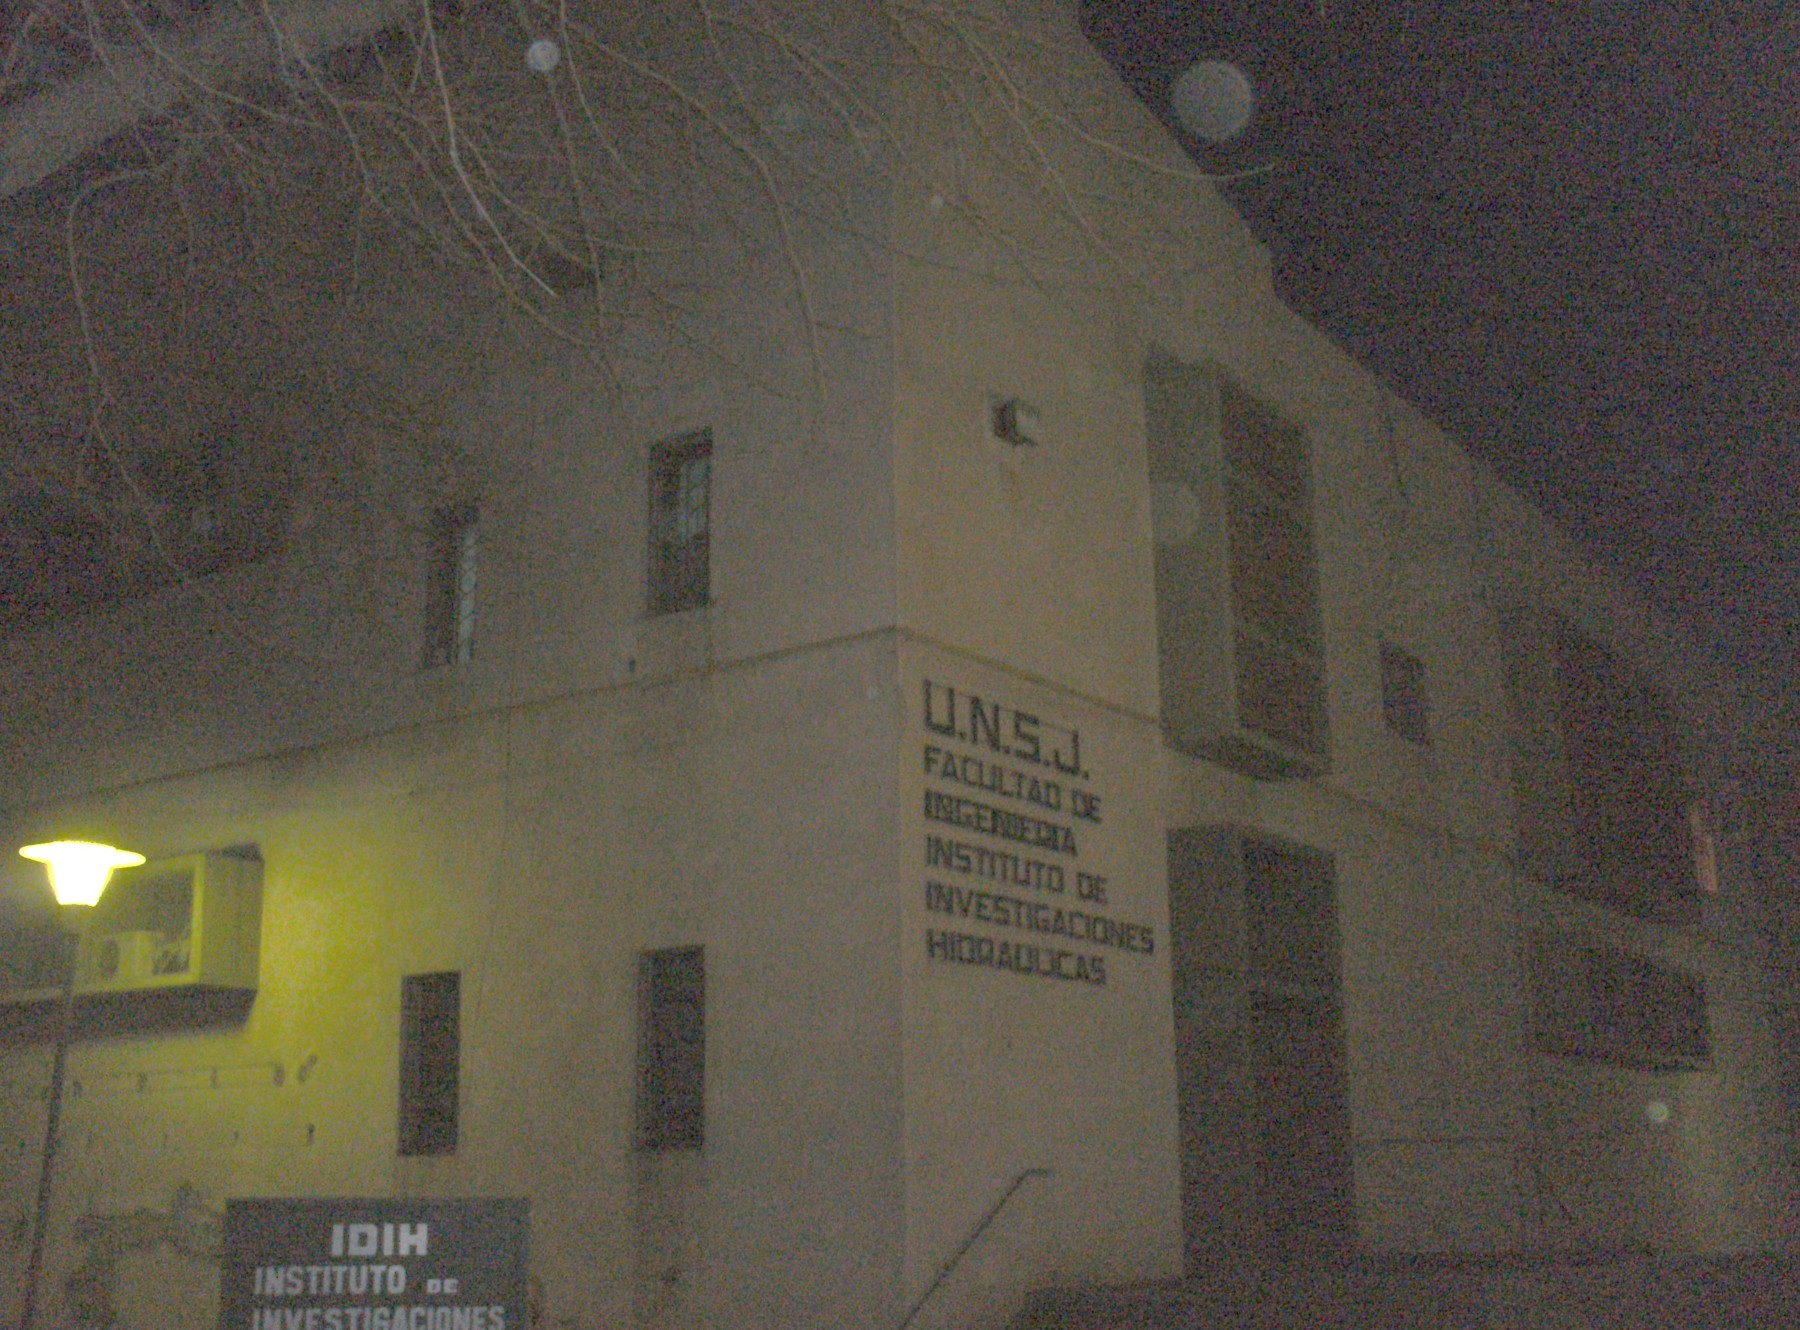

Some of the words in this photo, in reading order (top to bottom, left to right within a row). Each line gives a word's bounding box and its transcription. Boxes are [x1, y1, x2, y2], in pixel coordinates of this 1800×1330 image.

[923, 745, 1061, 812] FACULTAD
[1071, 788, 1101, 825] DE
[923, 787, 1078, 857] INGENIERIA
[924, 833, 1065, 895] INSTITUTO
[1077, 870, 1107, 904] DE
[924, 880, 1155, 955] INVESTIGACIONES
[925, 927, 1107, 985] HIDRAULICAS
[331, 1222, 429, 1257] IDIH
[253, 1264, 407, 1296] INSTITUTO
[426, 1277, 459, 1295] DE
[252, 1304, 505, 1330] INVESTIGACIONES
